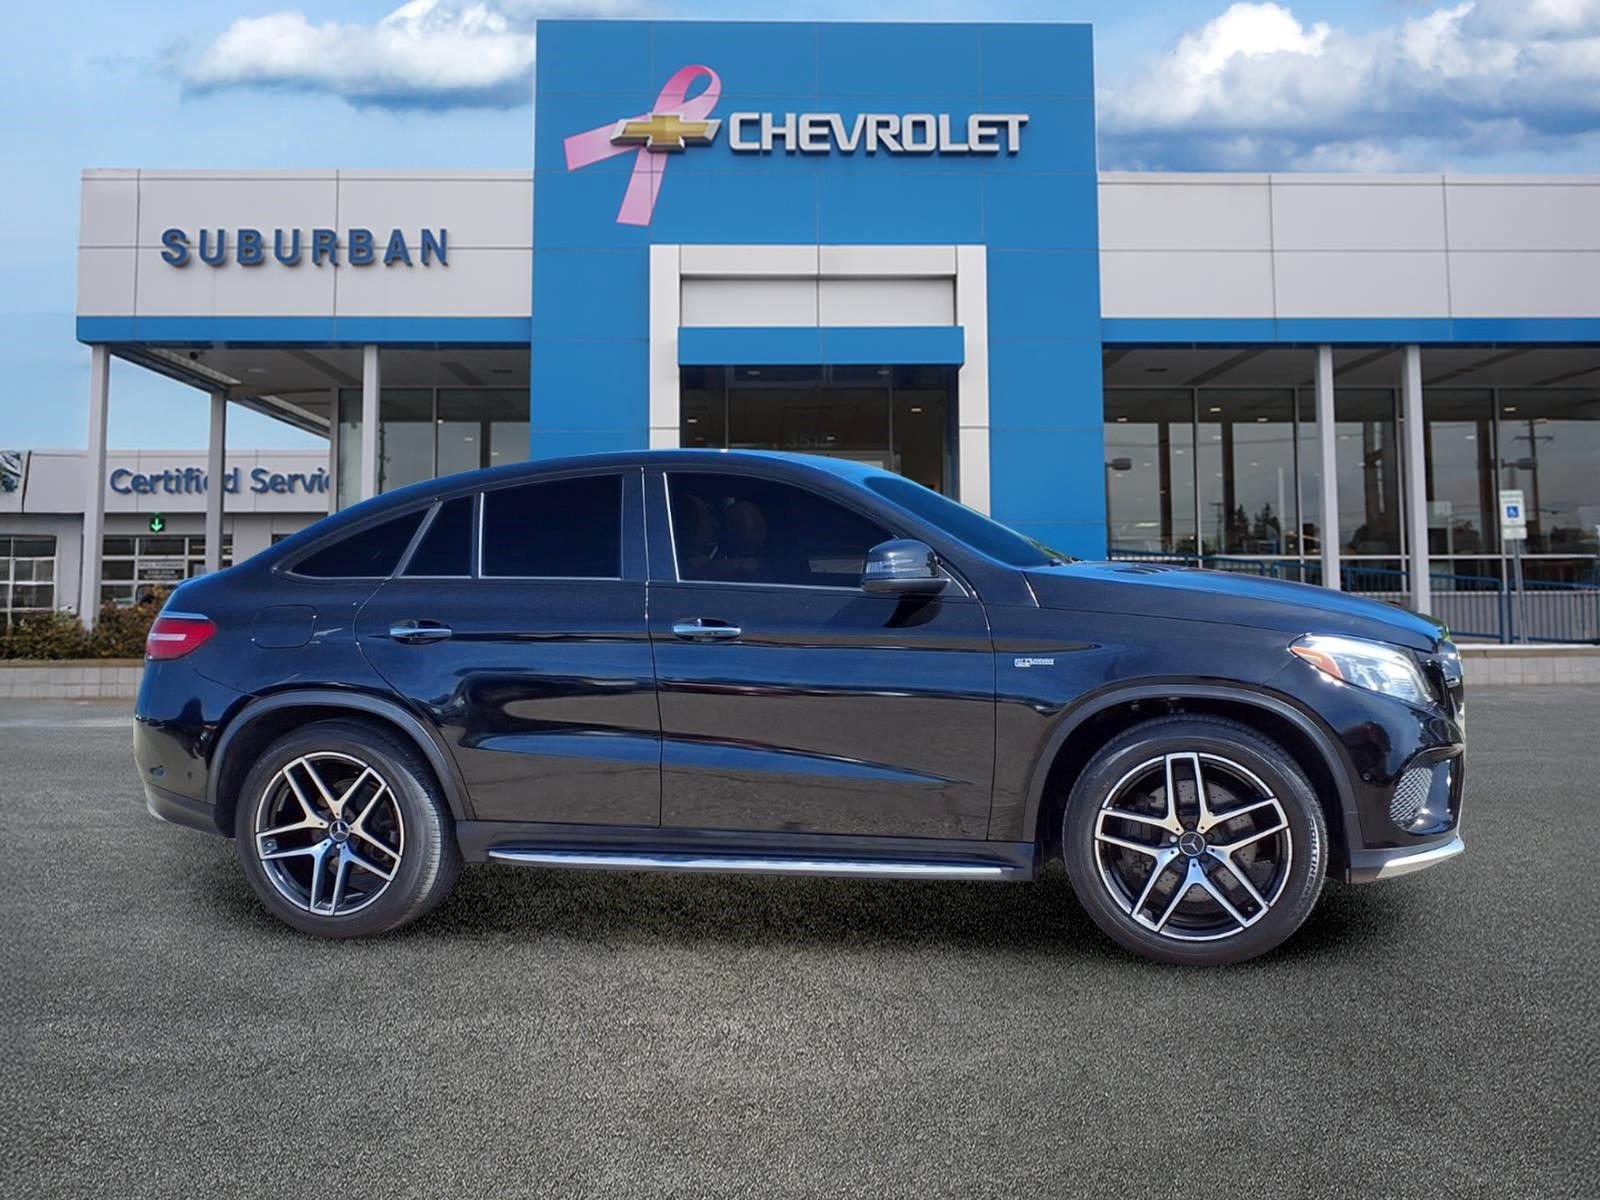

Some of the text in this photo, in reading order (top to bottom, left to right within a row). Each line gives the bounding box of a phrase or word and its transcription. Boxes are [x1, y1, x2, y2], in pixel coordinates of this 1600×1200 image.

[729, 112, 1030, 155] CHEVROLET
[161, 228, 448, 267] SUBURBAN
[110, 467, 240, 494] Certifid
